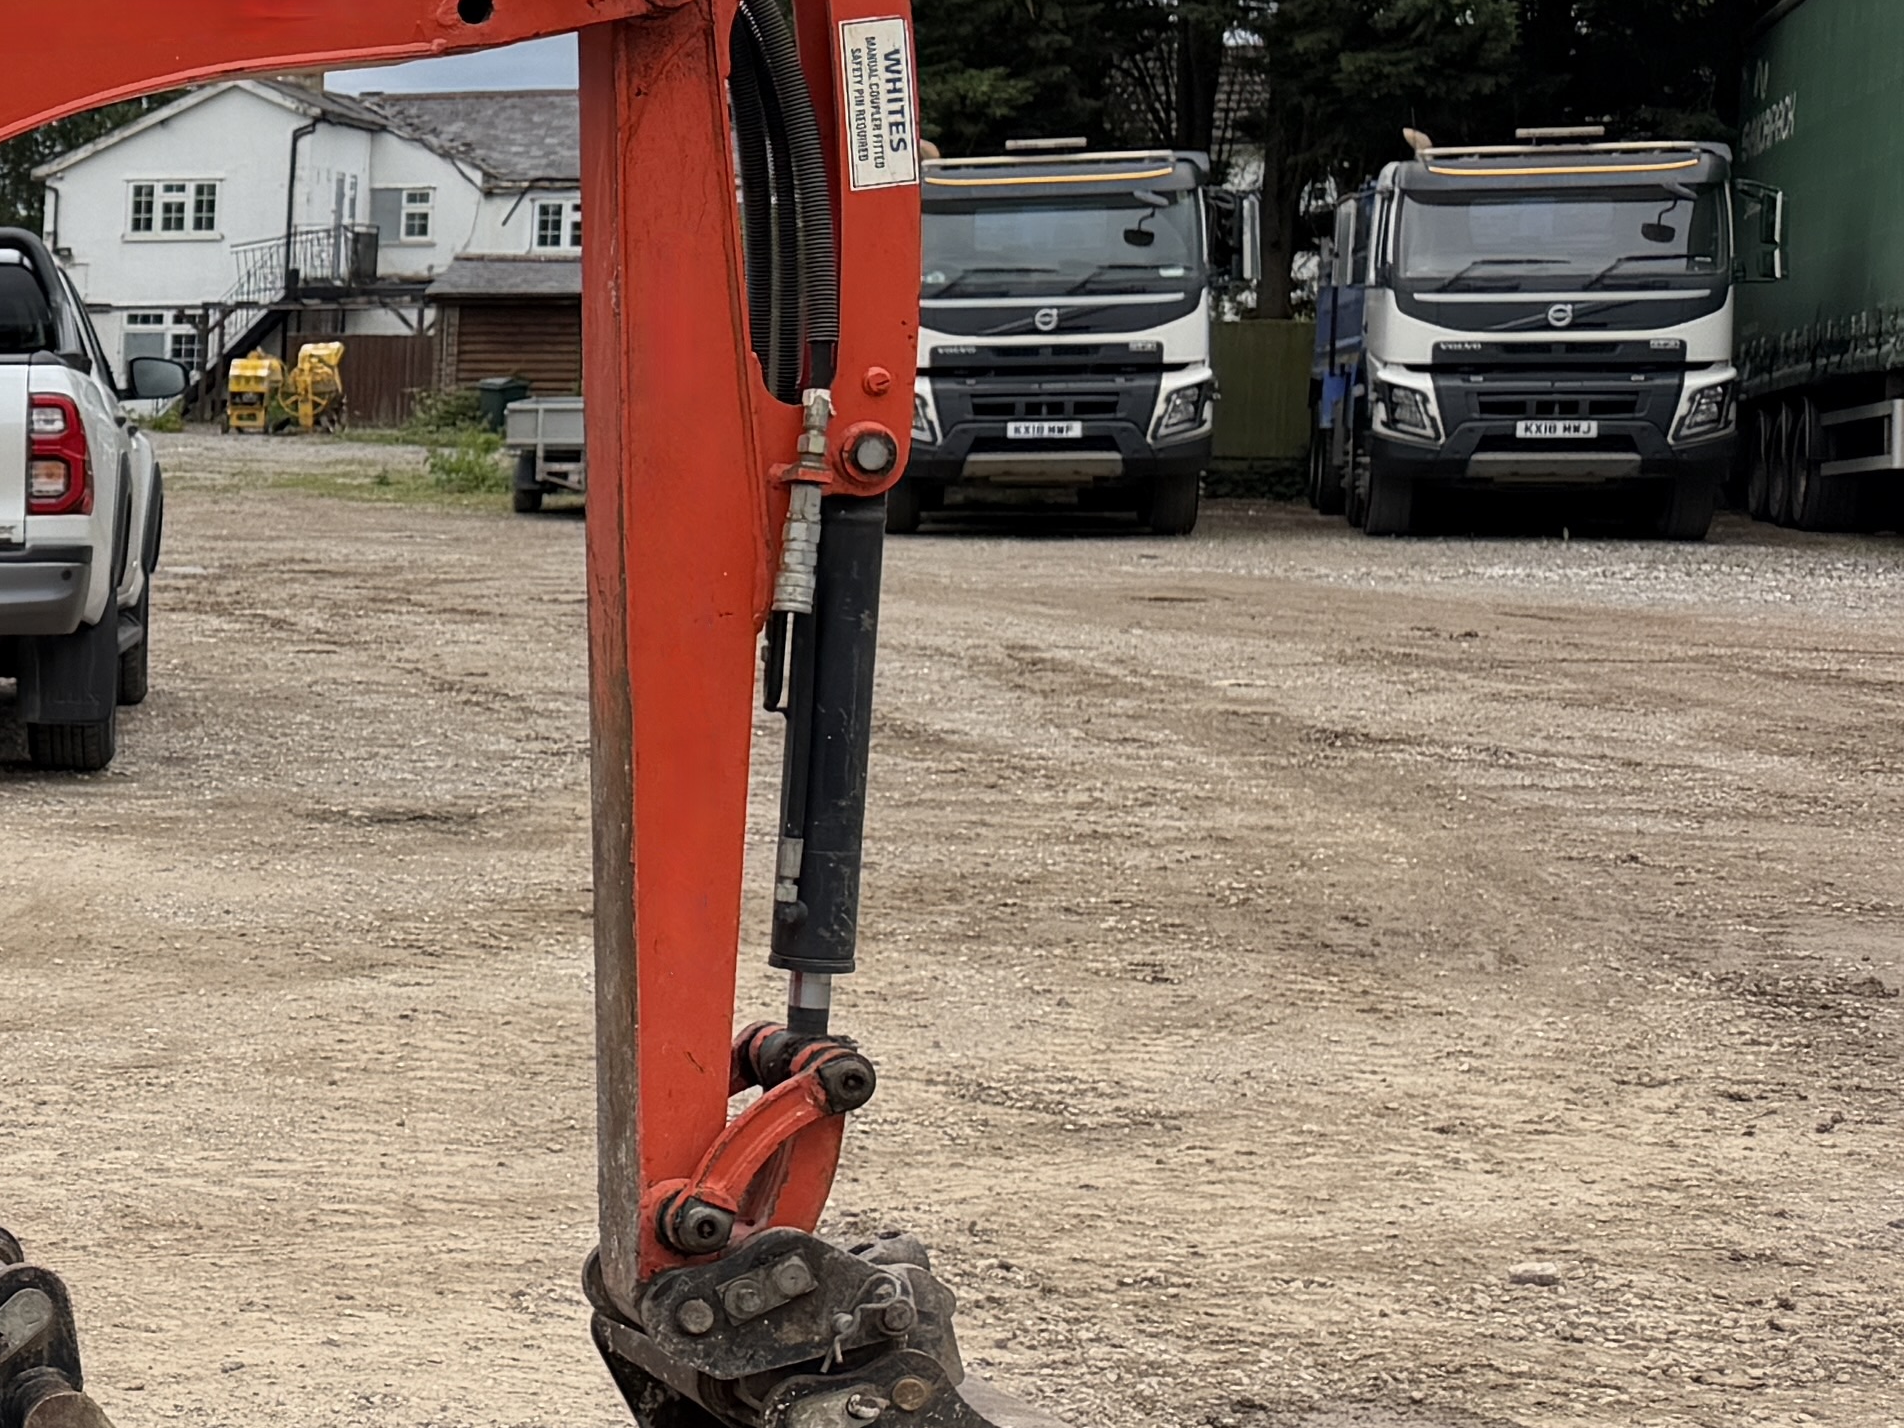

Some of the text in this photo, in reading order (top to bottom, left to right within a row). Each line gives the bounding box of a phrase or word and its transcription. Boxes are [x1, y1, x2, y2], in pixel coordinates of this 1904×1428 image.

[851, 48, 869, 162] SAFETY PIN REQUIRED
[865, 36, 880, 81] MANUAL
[873, 132, 885, 169] FITTED
[884, 48, 908, 153] WHITES
